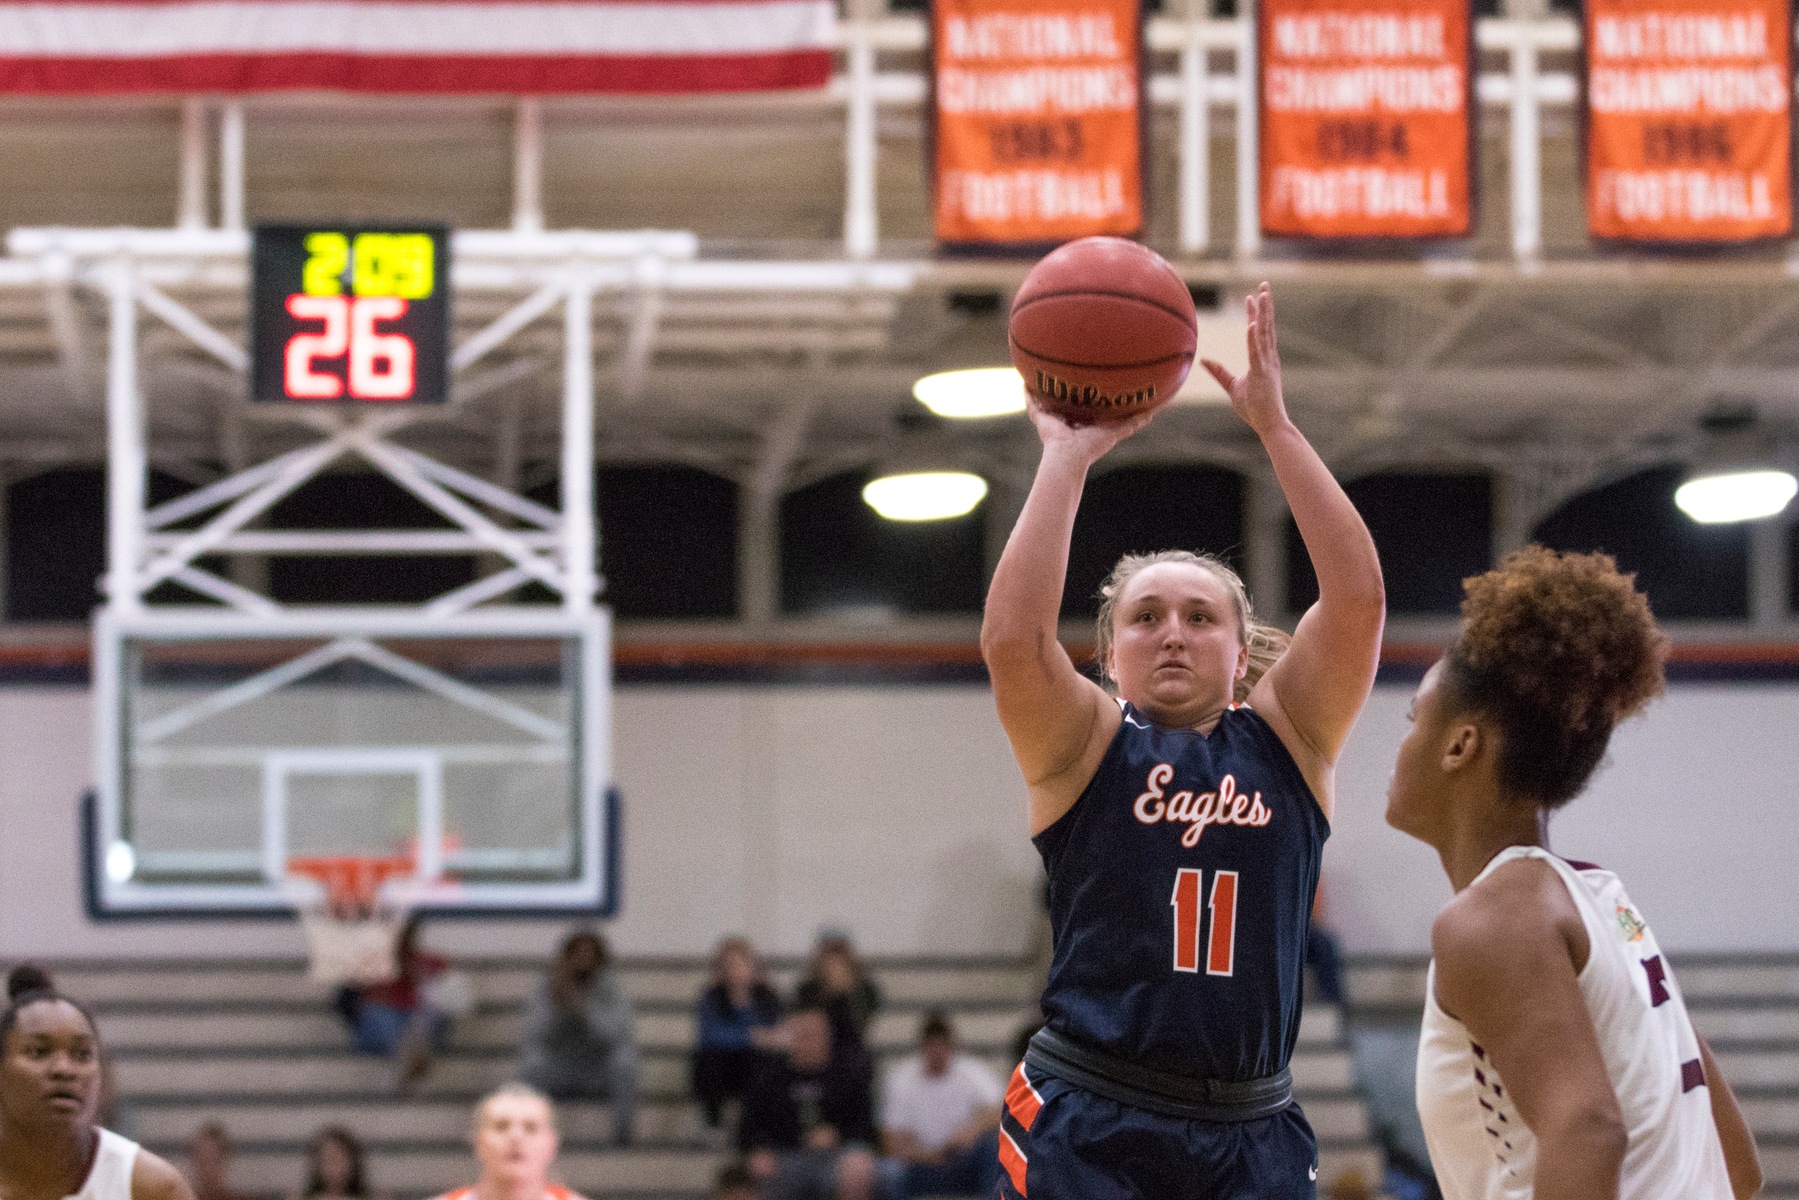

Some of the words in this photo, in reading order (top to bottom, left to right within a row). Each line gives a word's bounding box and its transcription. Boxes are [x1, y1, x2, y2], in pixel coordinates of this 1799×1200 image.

[946, 14, 1117, 56] NATIONAL
[1274, 14, 1444, 55] NATIONAL
[1597, 13, 1767, 56] NATIONAL
[938, 69, 1135, 111] CHAMPIONS
[1265, 67, 1462, 110] CHAMPIONS
[1590, 67, 1788, 111] CHAMPIONS
[944, 168, 1123, 219] FOOTBALL
[1270, 167, 1448, 218] FOOTBALL
[1596, 170, 1775, 220] FOOTBALL
[284, 293, 416, 399] 26
[1036, 370, 1156, 406] Wilson
[1133, 763, 1272, 848] Eagles
[1170, 867, 1239, 977] 11
